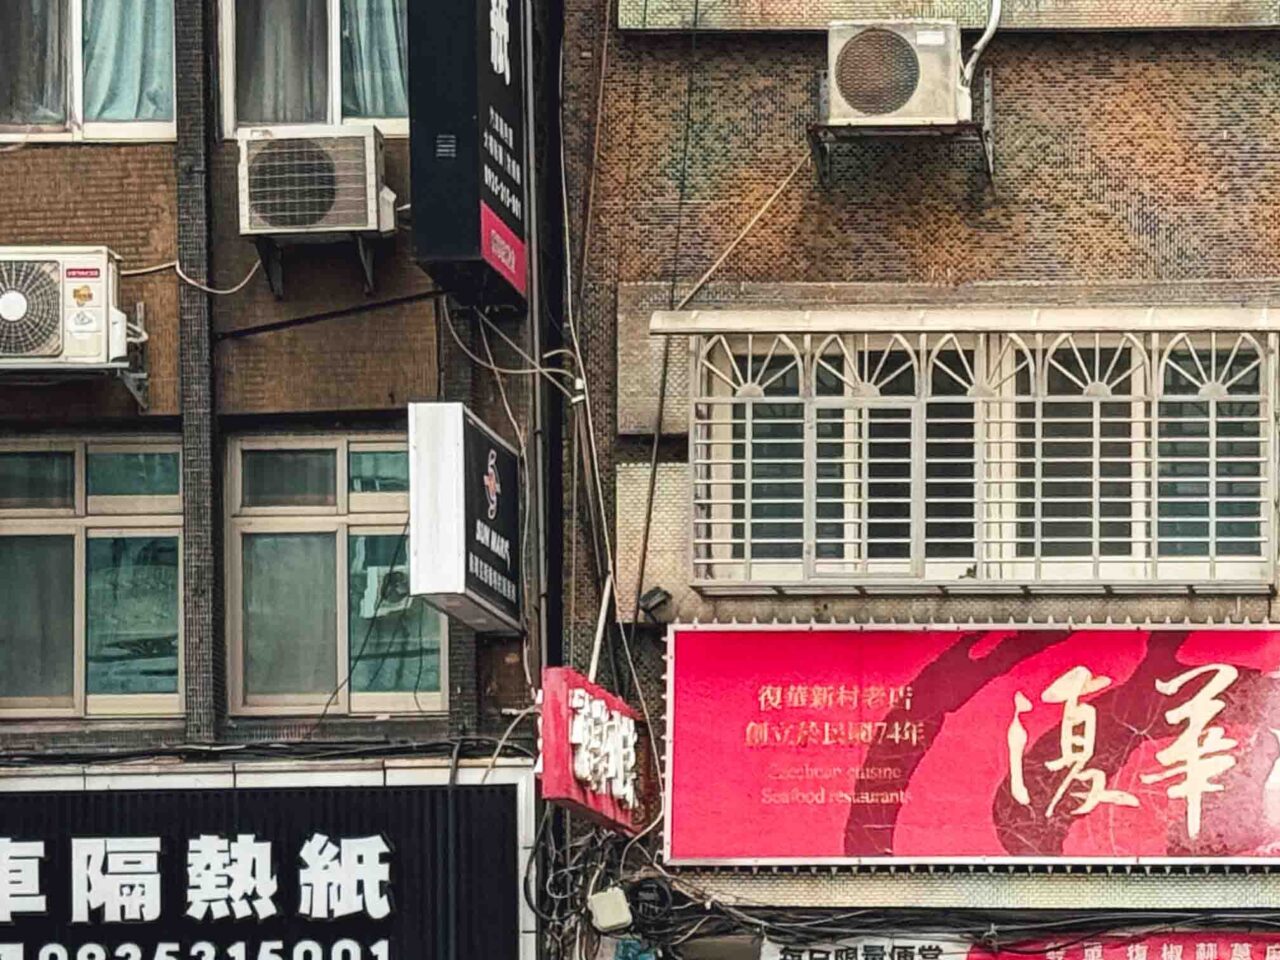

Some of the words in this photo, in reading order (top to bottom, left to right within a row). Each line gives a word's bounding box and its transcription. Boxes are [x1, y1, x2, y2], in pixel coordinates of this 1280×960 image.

[758, 684, 914, 711] 復華新村老店
[760, 786, 826, 805] Seafood
